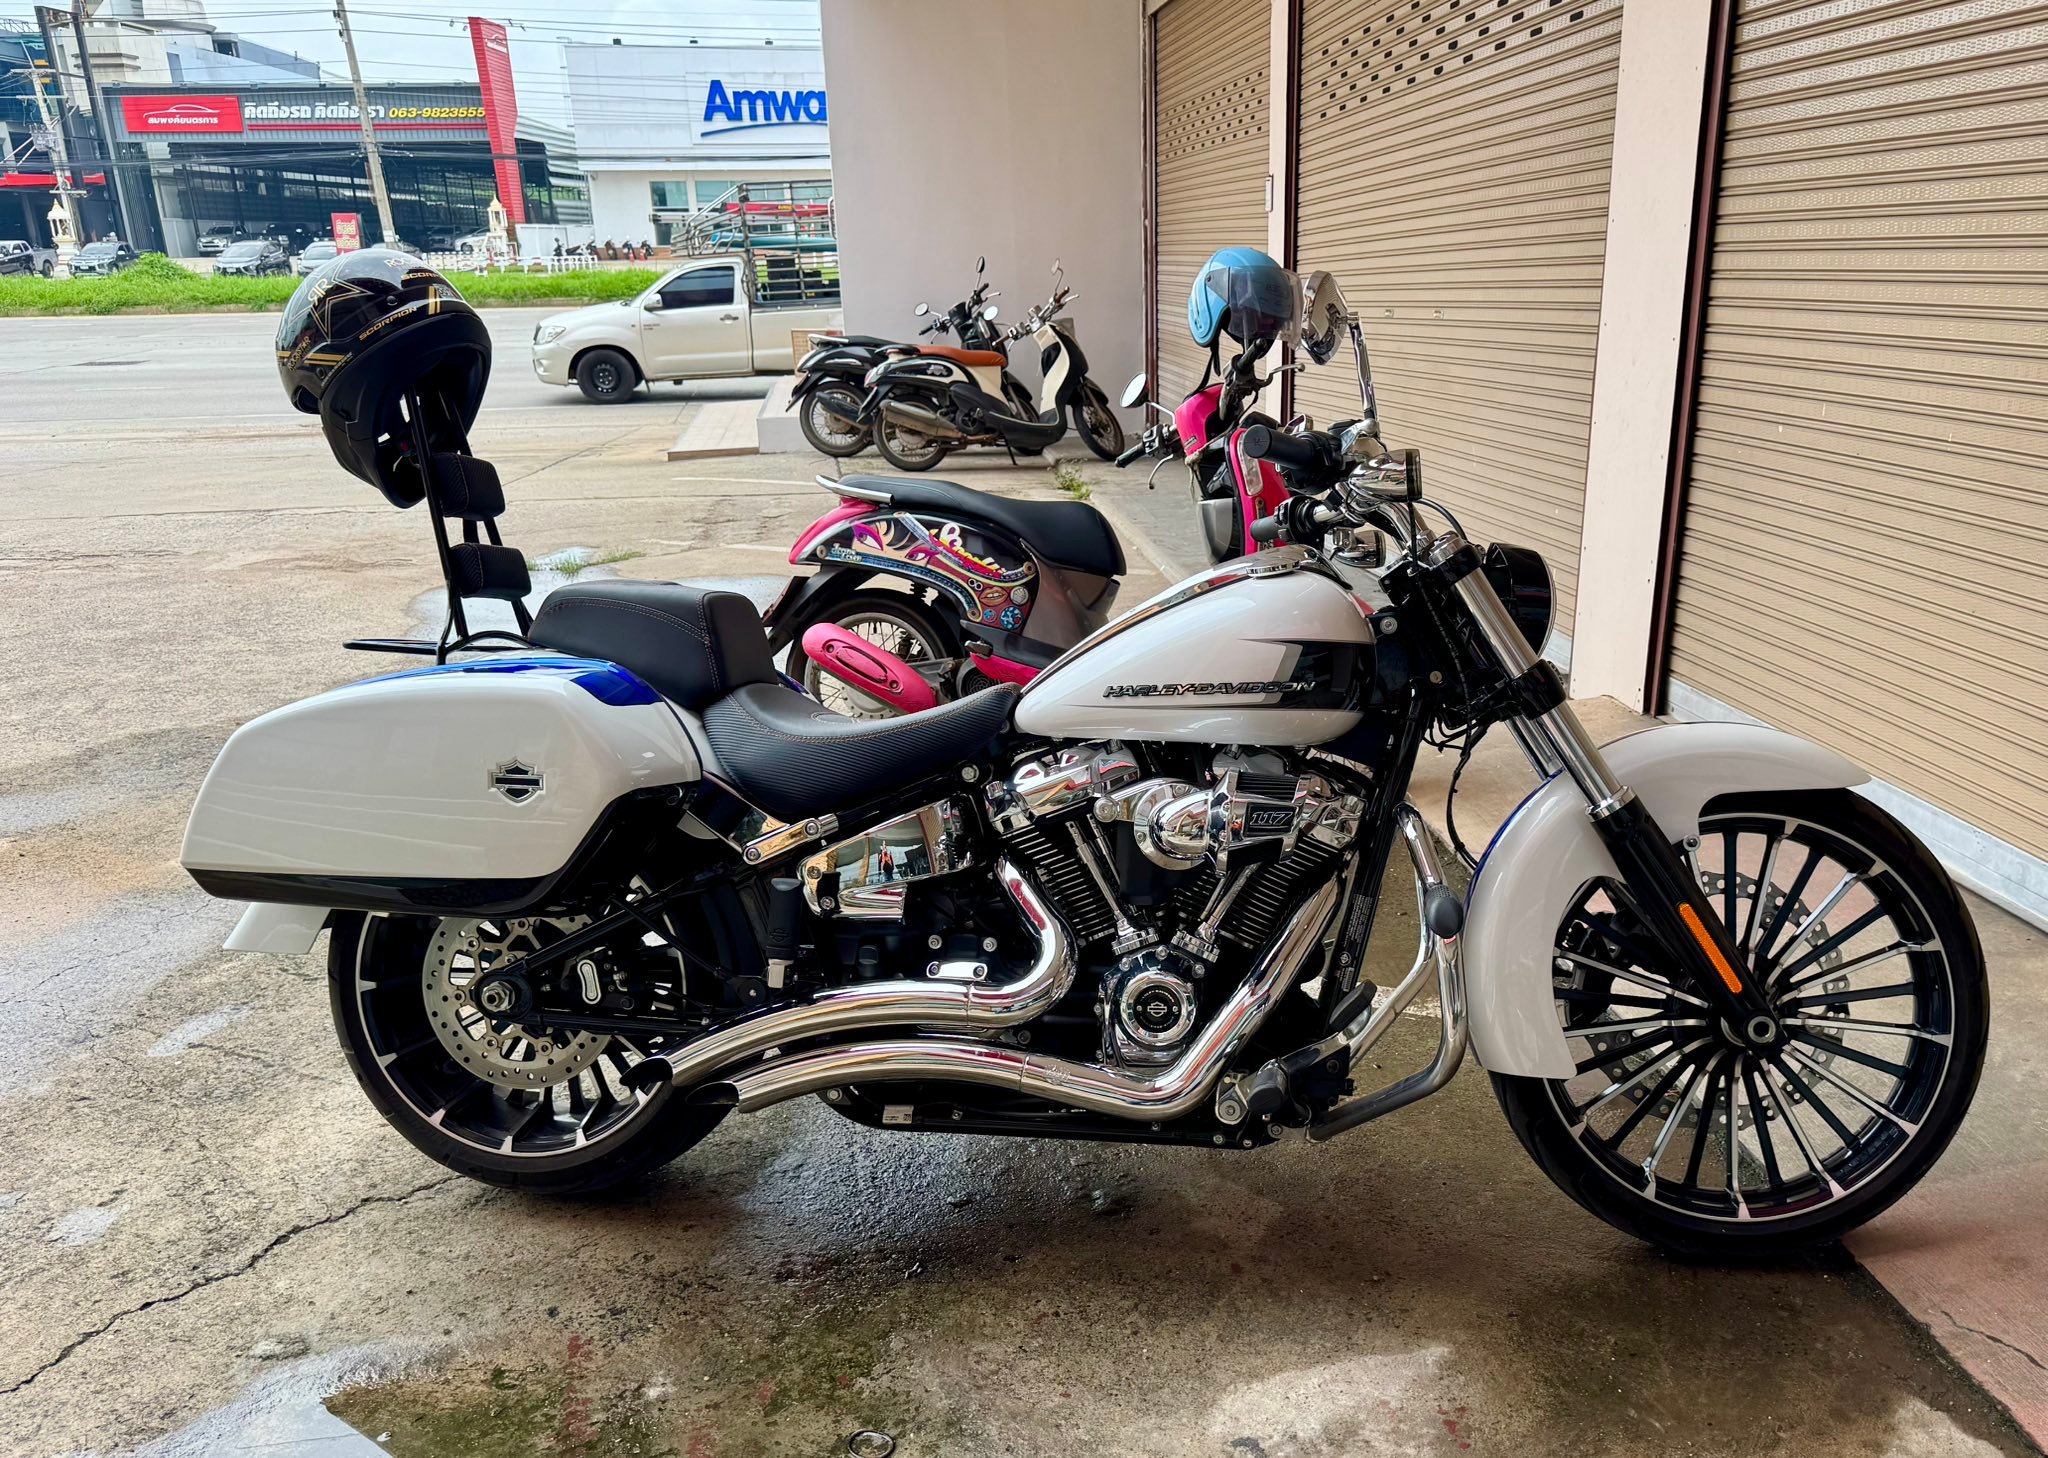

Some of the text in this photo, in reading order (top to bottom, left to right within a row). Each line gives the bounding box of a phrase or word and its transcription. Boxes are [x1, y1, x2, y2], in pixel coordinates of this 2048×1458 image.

[244, 101, 486, 118] คิดถึงรถ คิดถึงรา 063-9823555
[359, 306, 417, 341] SCORPION
[1102, 681, 1316, 698] HARLEY-DAVIDSON
[1249, 811, 1293, 826] 117
